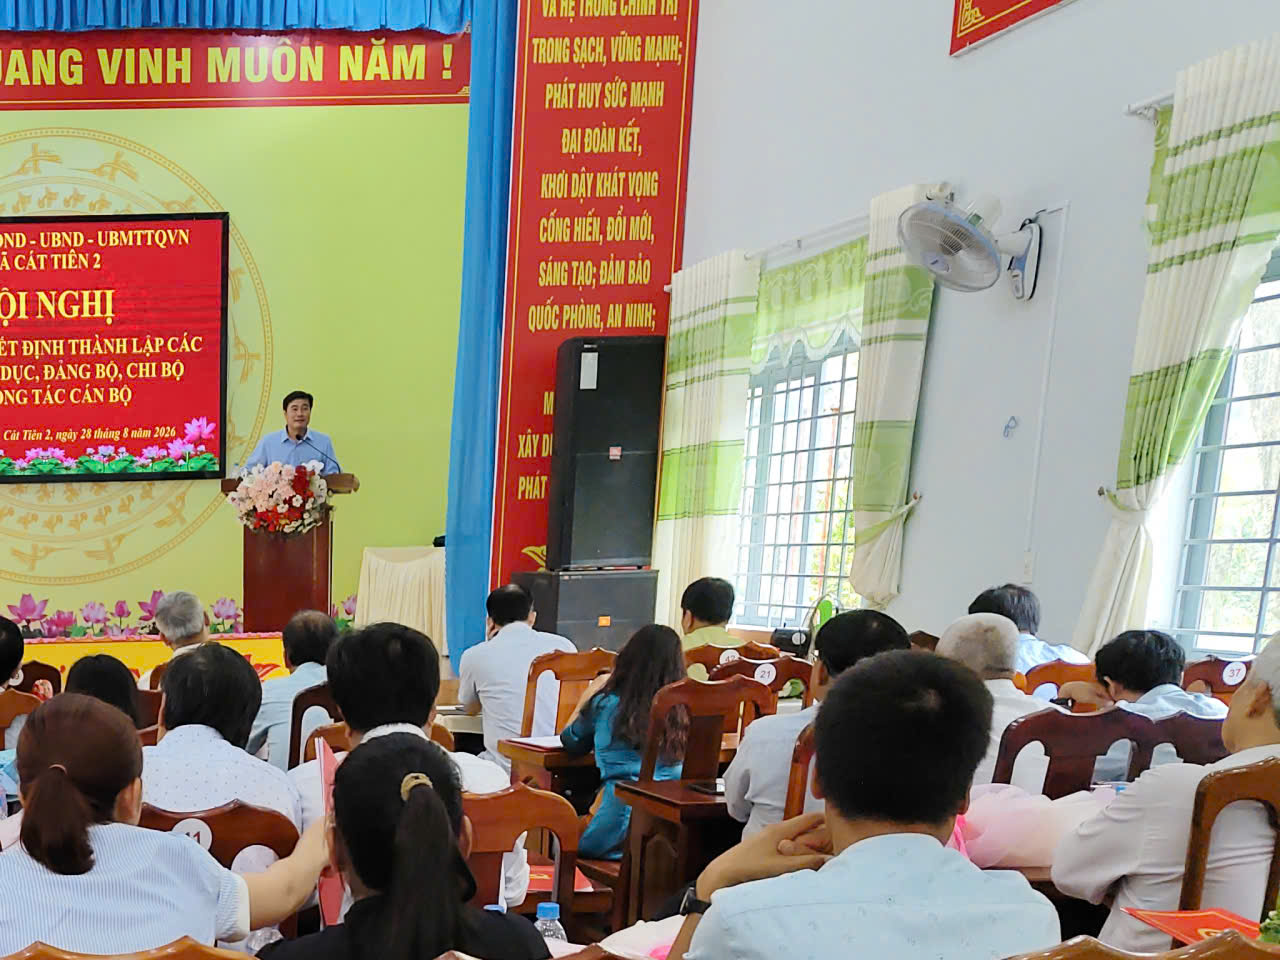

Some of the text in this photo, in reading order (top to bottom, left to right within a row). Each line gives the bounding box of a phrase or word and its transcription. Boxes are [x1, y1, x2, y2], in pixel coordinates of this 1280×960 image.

[96, 46, 192, 86] VINH
[207, 38, 323, 85] MUÔN
[340, 37, 426, 82] NĂM
[441, 44, 454, 80] !
[532, 30, 683, 69] TRONG SẠCH, VỮNG MẠNH;
[545, 75, 665, 113] PHÁT HUY SỨC MẠNH
[561, 118, 642, 159] ĐẠI ĐOÀN KẾT,
[571, 166, 594, 204] DẬY
[596, 166, 626, 198] KHÁT
[628, 171, 659, 203] VỌNG
[40, 231, 84, 248] UBND
[97, 229, 190, 249] UBMTTQVN
[539, 205, 655, 246] CỐNG HIẾN, ĐỔI MỚI,
[14, 250, 48, 271] CÁT
[51, 249, 89, 270] TIÊN
[93, 252, 101, 269] 2
[538, 252, 651, 291] SÁNG TẠO; ĐẢM BẢO
[36, 289, 115, 326] NGHỊ
[528, 296, 656, 333] QUỐC PHÒNG, AN NINH;
[22, 339, 64, 359] ĐỊNH
[68, 334, 127, 356] THÀNH
[132, 335, 164, 357] LẬP
[167, 332, 203, 353] CÁC
[0, 364, 40, 384] DỤC,
[43, 360, 91, 380] ĐẢNG
[95, 361, 123, 382] BỘ,
[126, 362, 157, 379] CHI
[161, 359, 184, 381] BỘ
[32, 384, 66, 404] TÁC
[69, 384, 104, 404] CÁN
[109, 384, 132, 406] BỘ
[3, 426, 176, 443] Cát Tiên 2, ngày 28 tháng 8 năm 2026
[517, 428, 540, 459] XÂY
[518, 471, 548, 500] PHÁT
[760, 670, 771, 679] 21
[1228, 668, 1241, 678] 37
